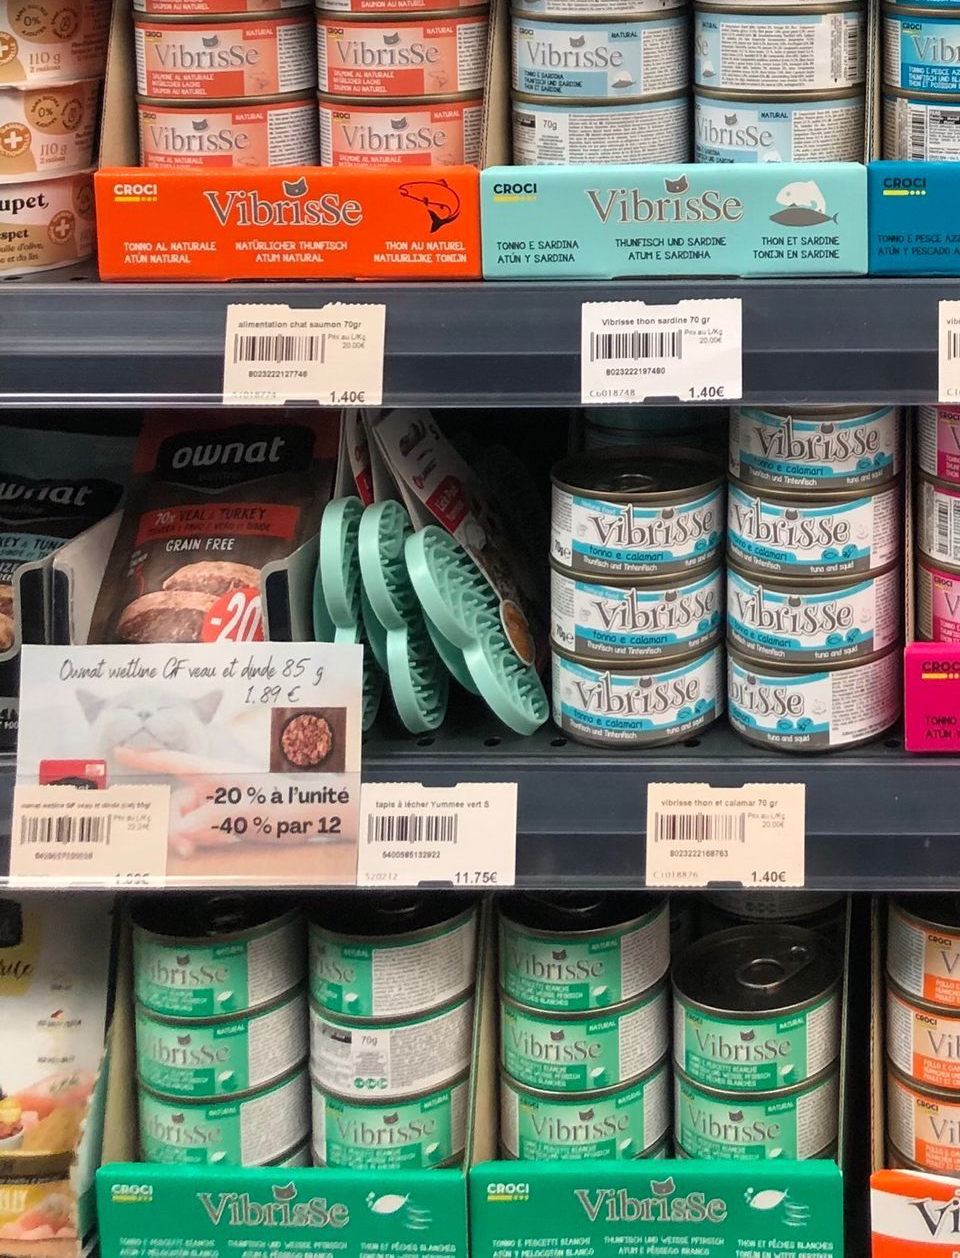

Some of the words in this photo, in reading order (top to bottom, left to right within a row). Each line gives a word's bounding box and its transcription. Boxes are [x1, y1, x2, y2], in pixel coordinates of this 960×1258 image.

[114, 184, 157, 195] CROCI
[493, 183, 537, 194] CROCI
[616, 238, 664, 248] THUNFISCH
[668, 237, 684, 247] UND
[687, 236, 727, 246] SARDINE
[701, 317, 710, 325] gr
[330, 391, 365, 403] 1.40€
[689, 386, 724, 398] 1.40€
[172, 437, 285, 469] ownat
[166, 539, 201, 552] GRAIN
[206, 538, 235, 550] FREE
[244, 686, 282, 704] 1.89
[287, 686, 302, 703] €
[206, 787, 242, 804] -20
[247, 787, 266, 804] %
[271, 786, 283, 804] à
[289, 786, 349, 804] l'unité
[211, 817, 248, 834] -40
[253, 816, 272, 834] %
[277, 820, 313, 838] par
[318, 816, 341, 834] 12
[455, 872, 497, 884] 11.75€
[752, 871, 786, 882] 1.40€
[111, 1185, 153, 1196] CROCI
[487, 1183, 529, 1194] CROCI
